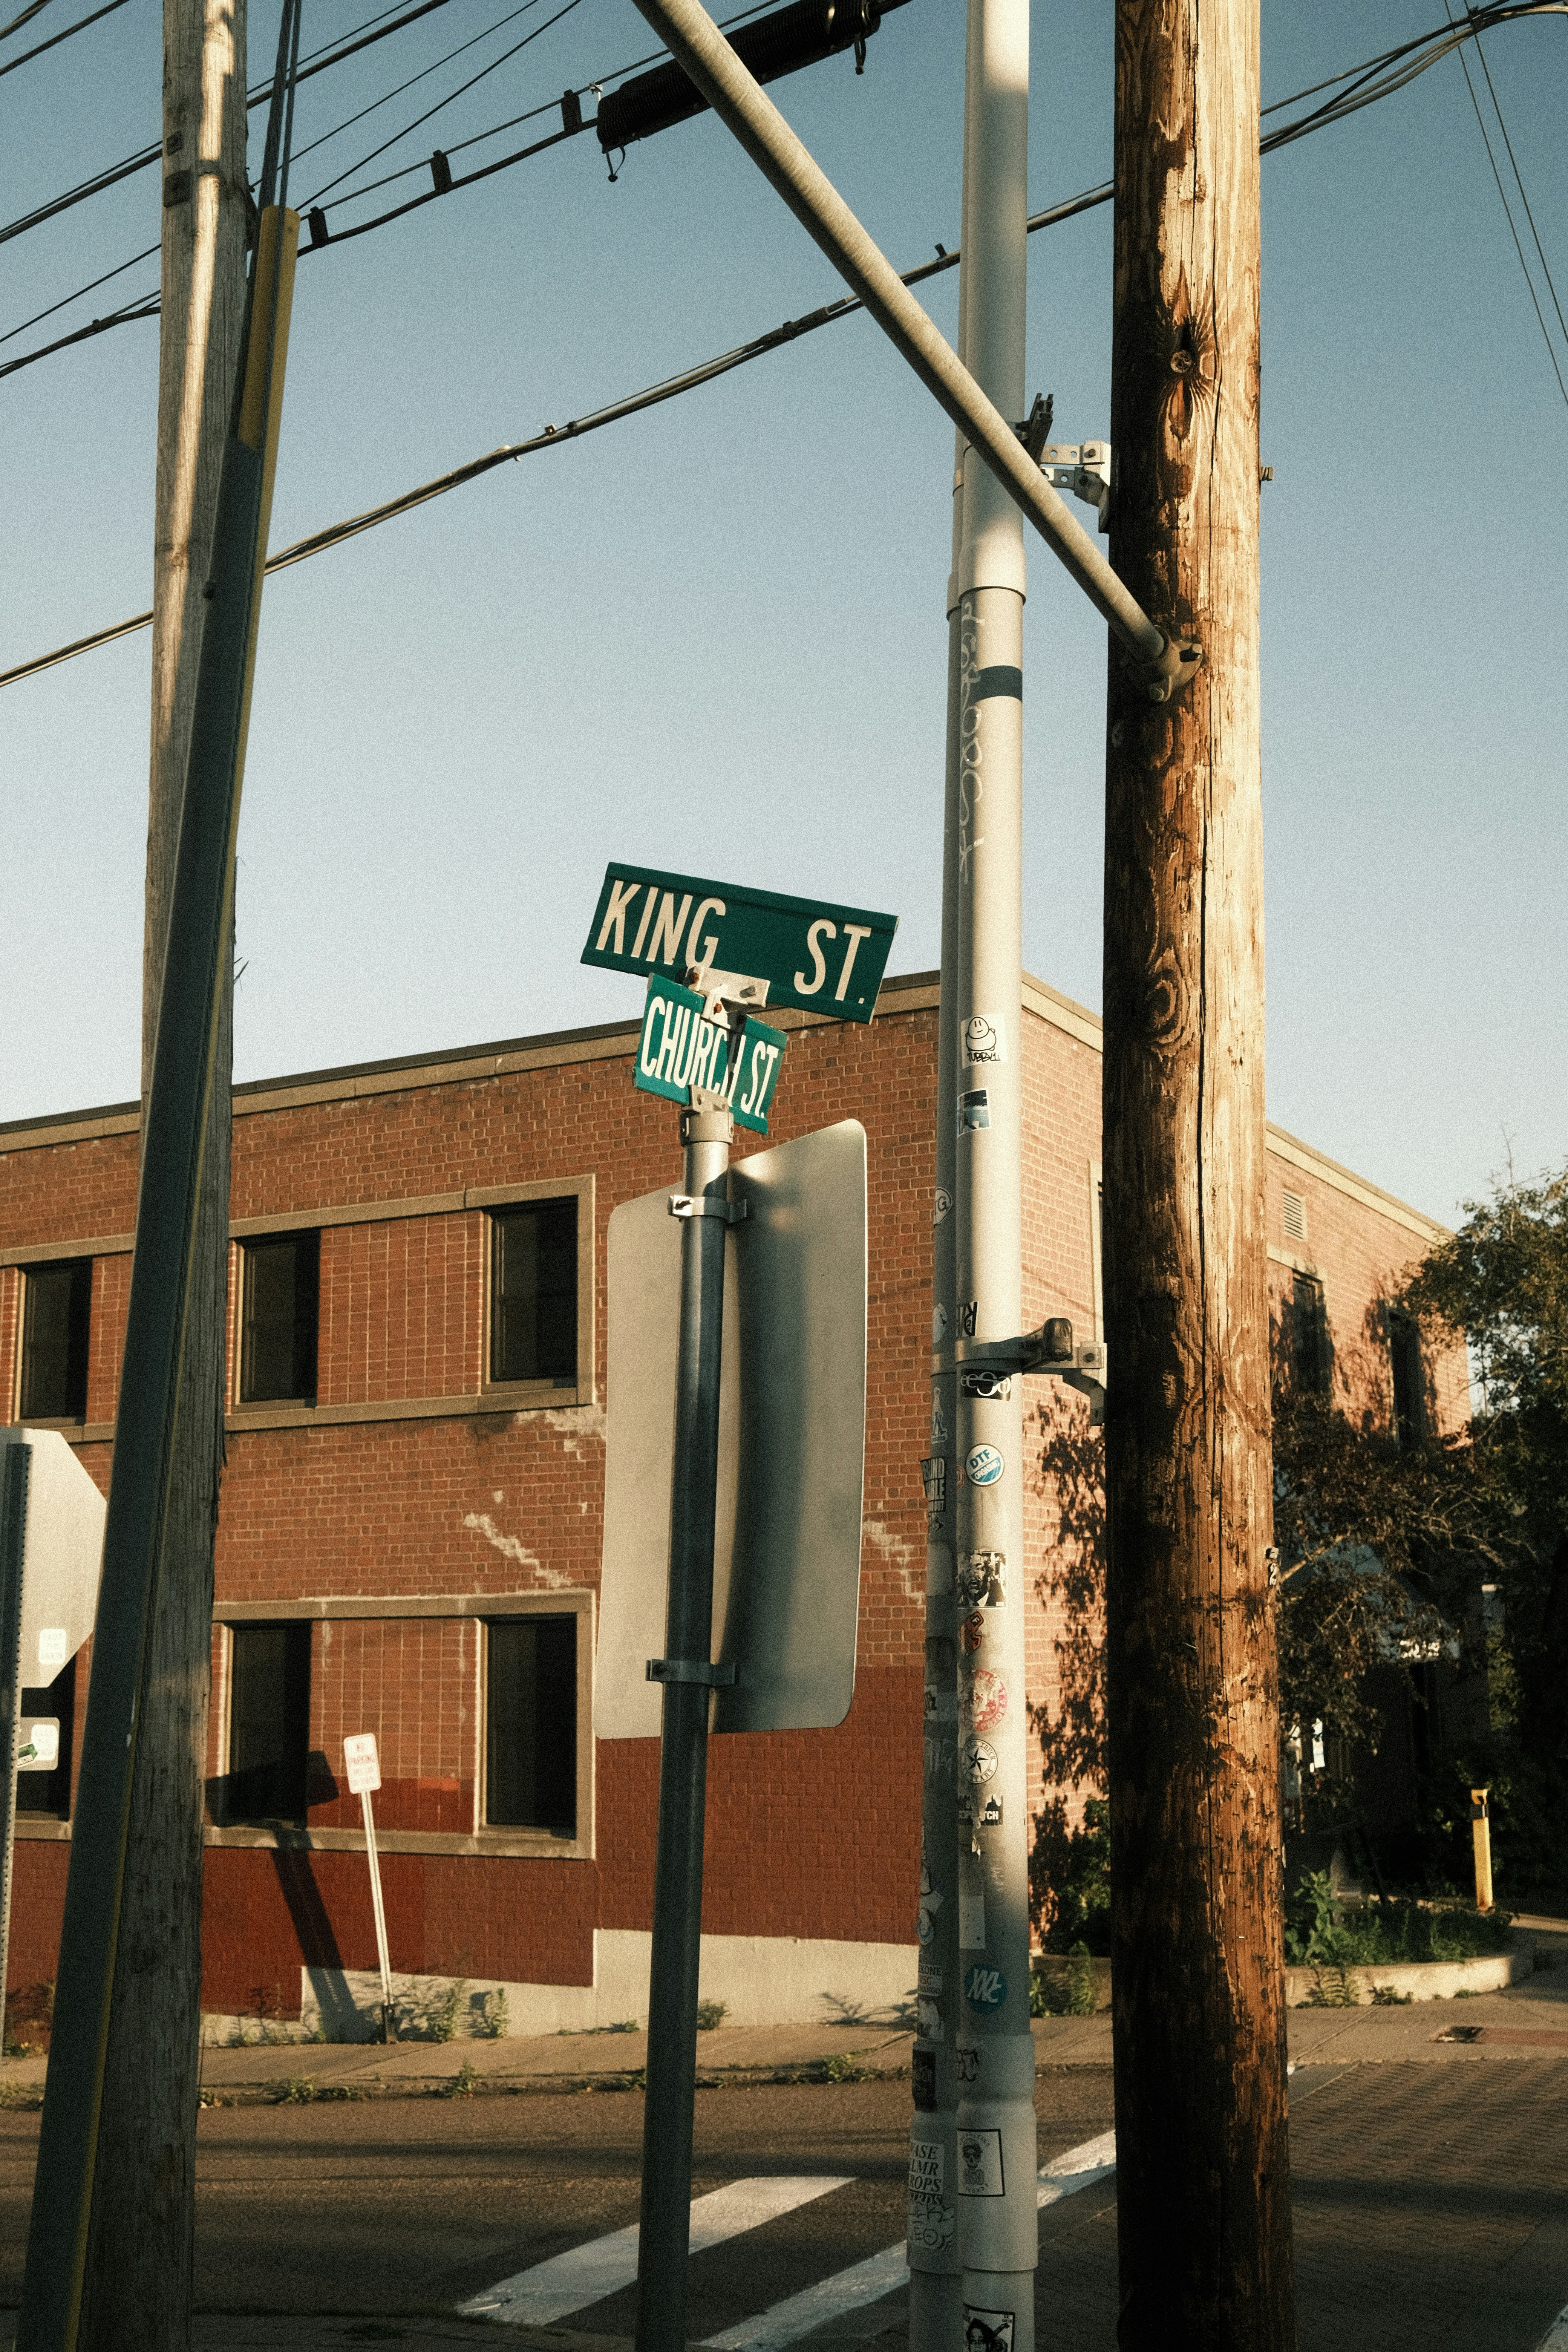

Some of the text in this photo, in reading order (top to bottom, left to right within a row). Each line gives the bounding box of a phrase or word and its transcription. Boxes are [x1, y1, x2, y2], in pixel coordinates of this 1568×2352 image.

[596, 880, 871, 1004] KING ST.
[640, 996, 779, 1118] CHURCH ST.
[969, 1449, 990, 1469] DTF
